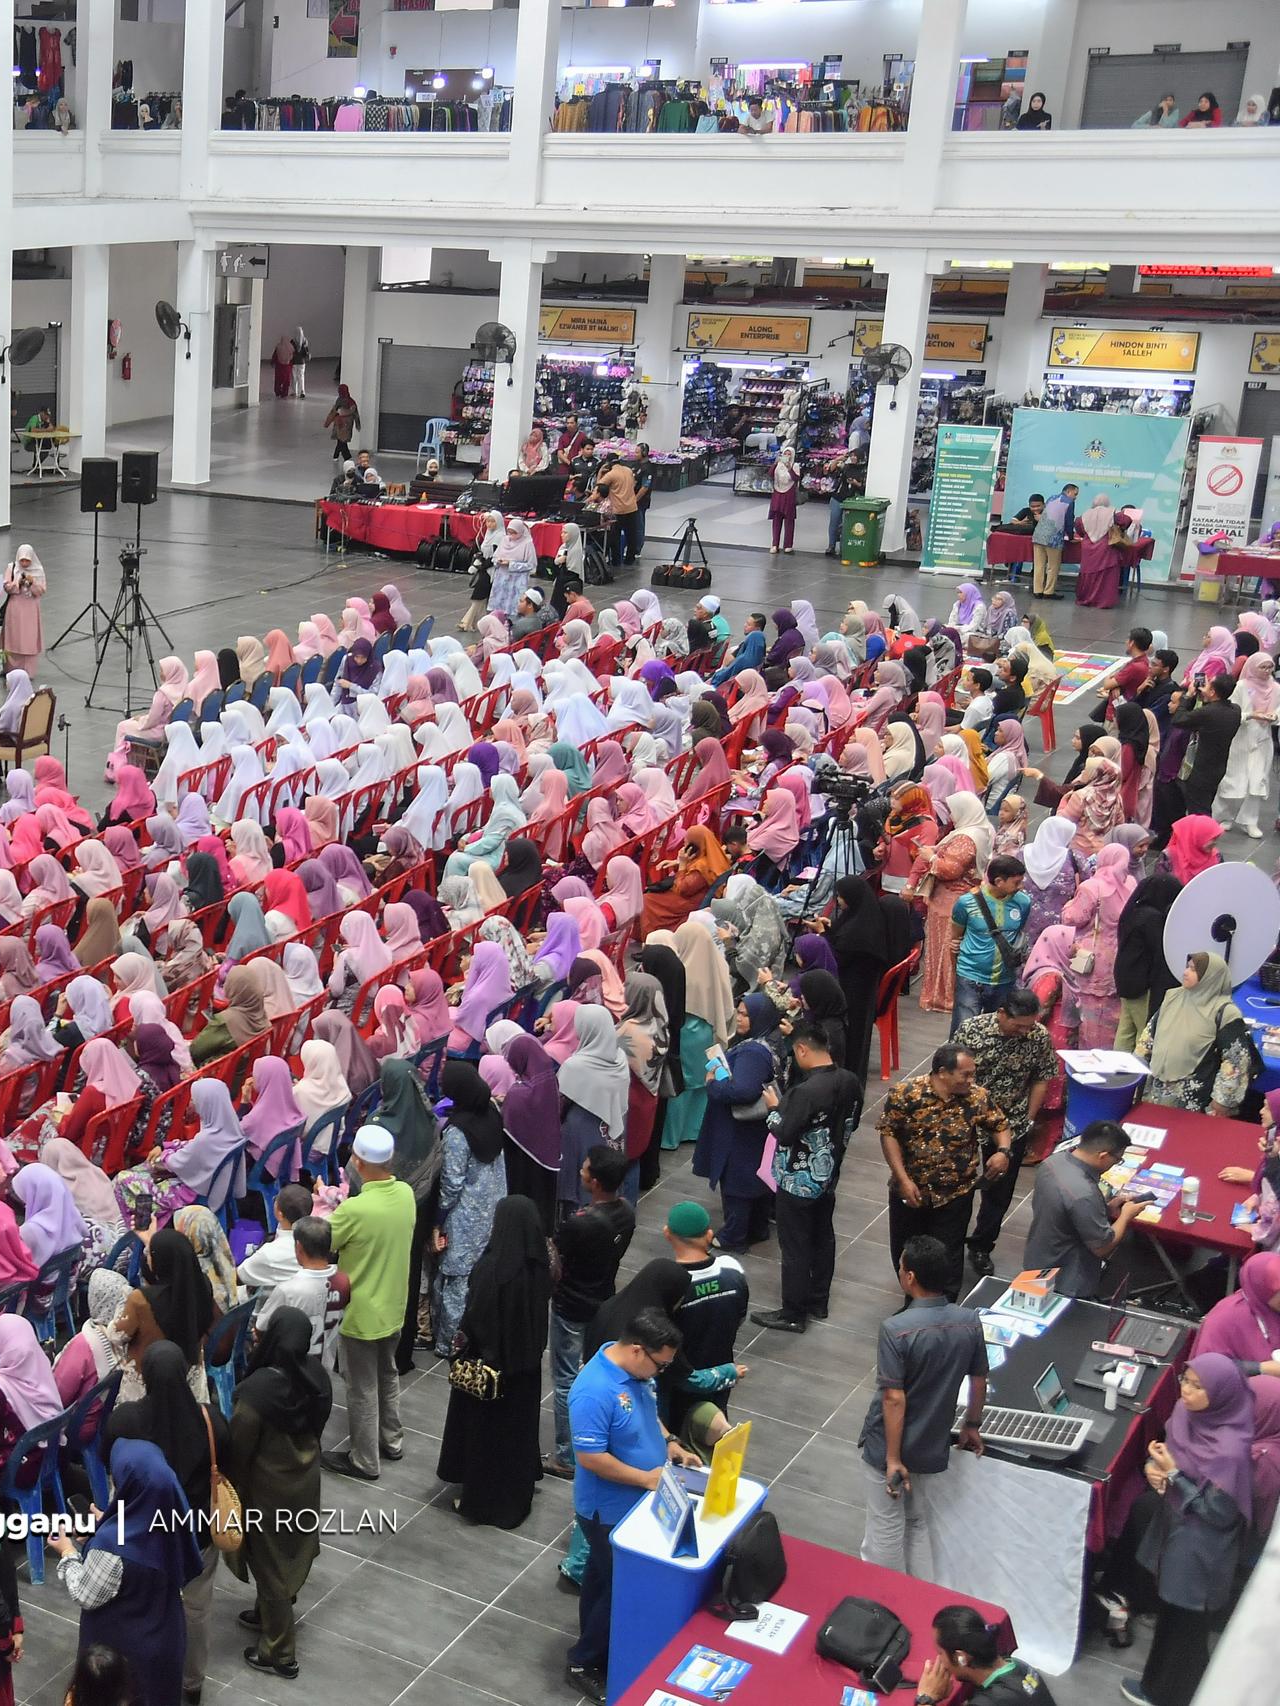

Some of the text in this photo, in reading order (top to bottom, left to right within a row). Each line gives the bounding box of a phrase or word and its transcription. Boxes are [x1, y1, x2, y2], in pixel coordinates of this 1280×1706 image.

[740, 332, 780, 340] ENTERPRISE
[1110, 340, 1168, 350] HINDON BINTI
[1122, 349, 1153, 357] SALLEH
[694, 1279, 720, 1297] N15
